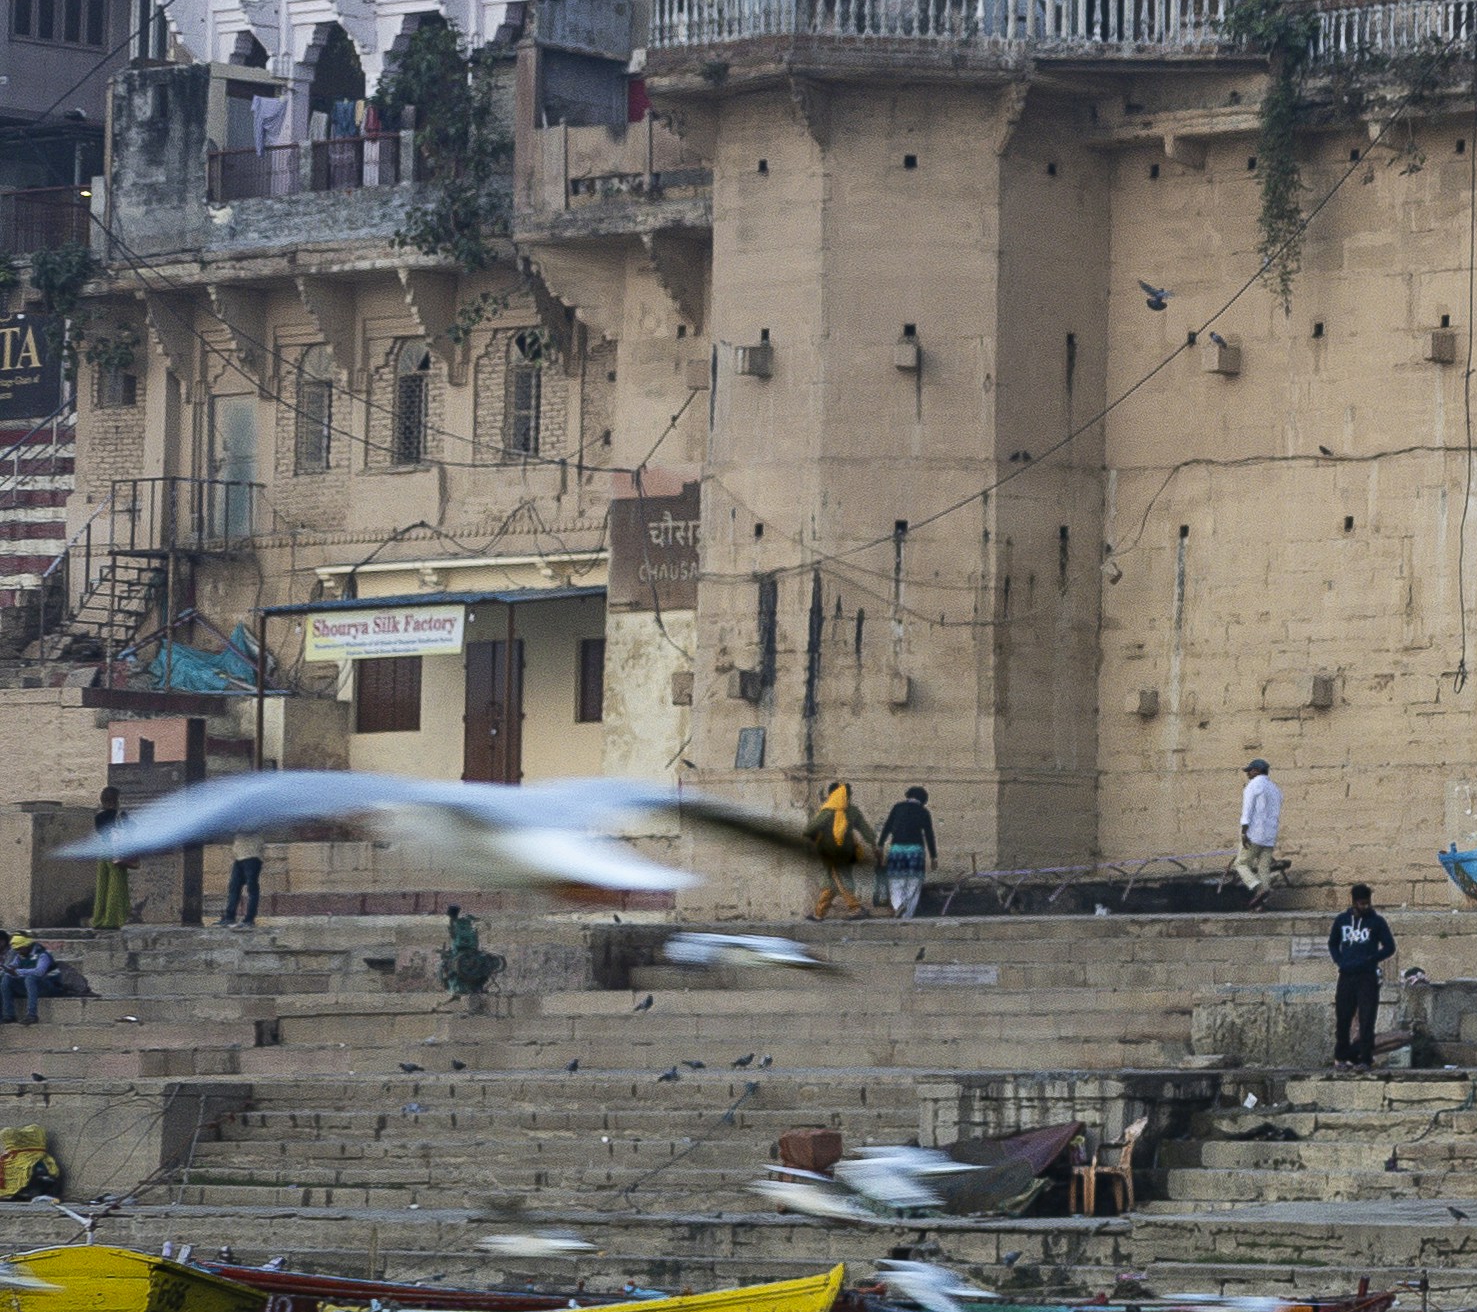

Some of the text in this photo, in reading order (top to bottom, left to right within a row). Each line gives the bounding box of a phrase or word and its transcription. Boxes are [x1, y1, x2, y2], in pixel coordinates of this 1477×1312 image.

[312, 613, 456, 639] Shourya Silk Factory
